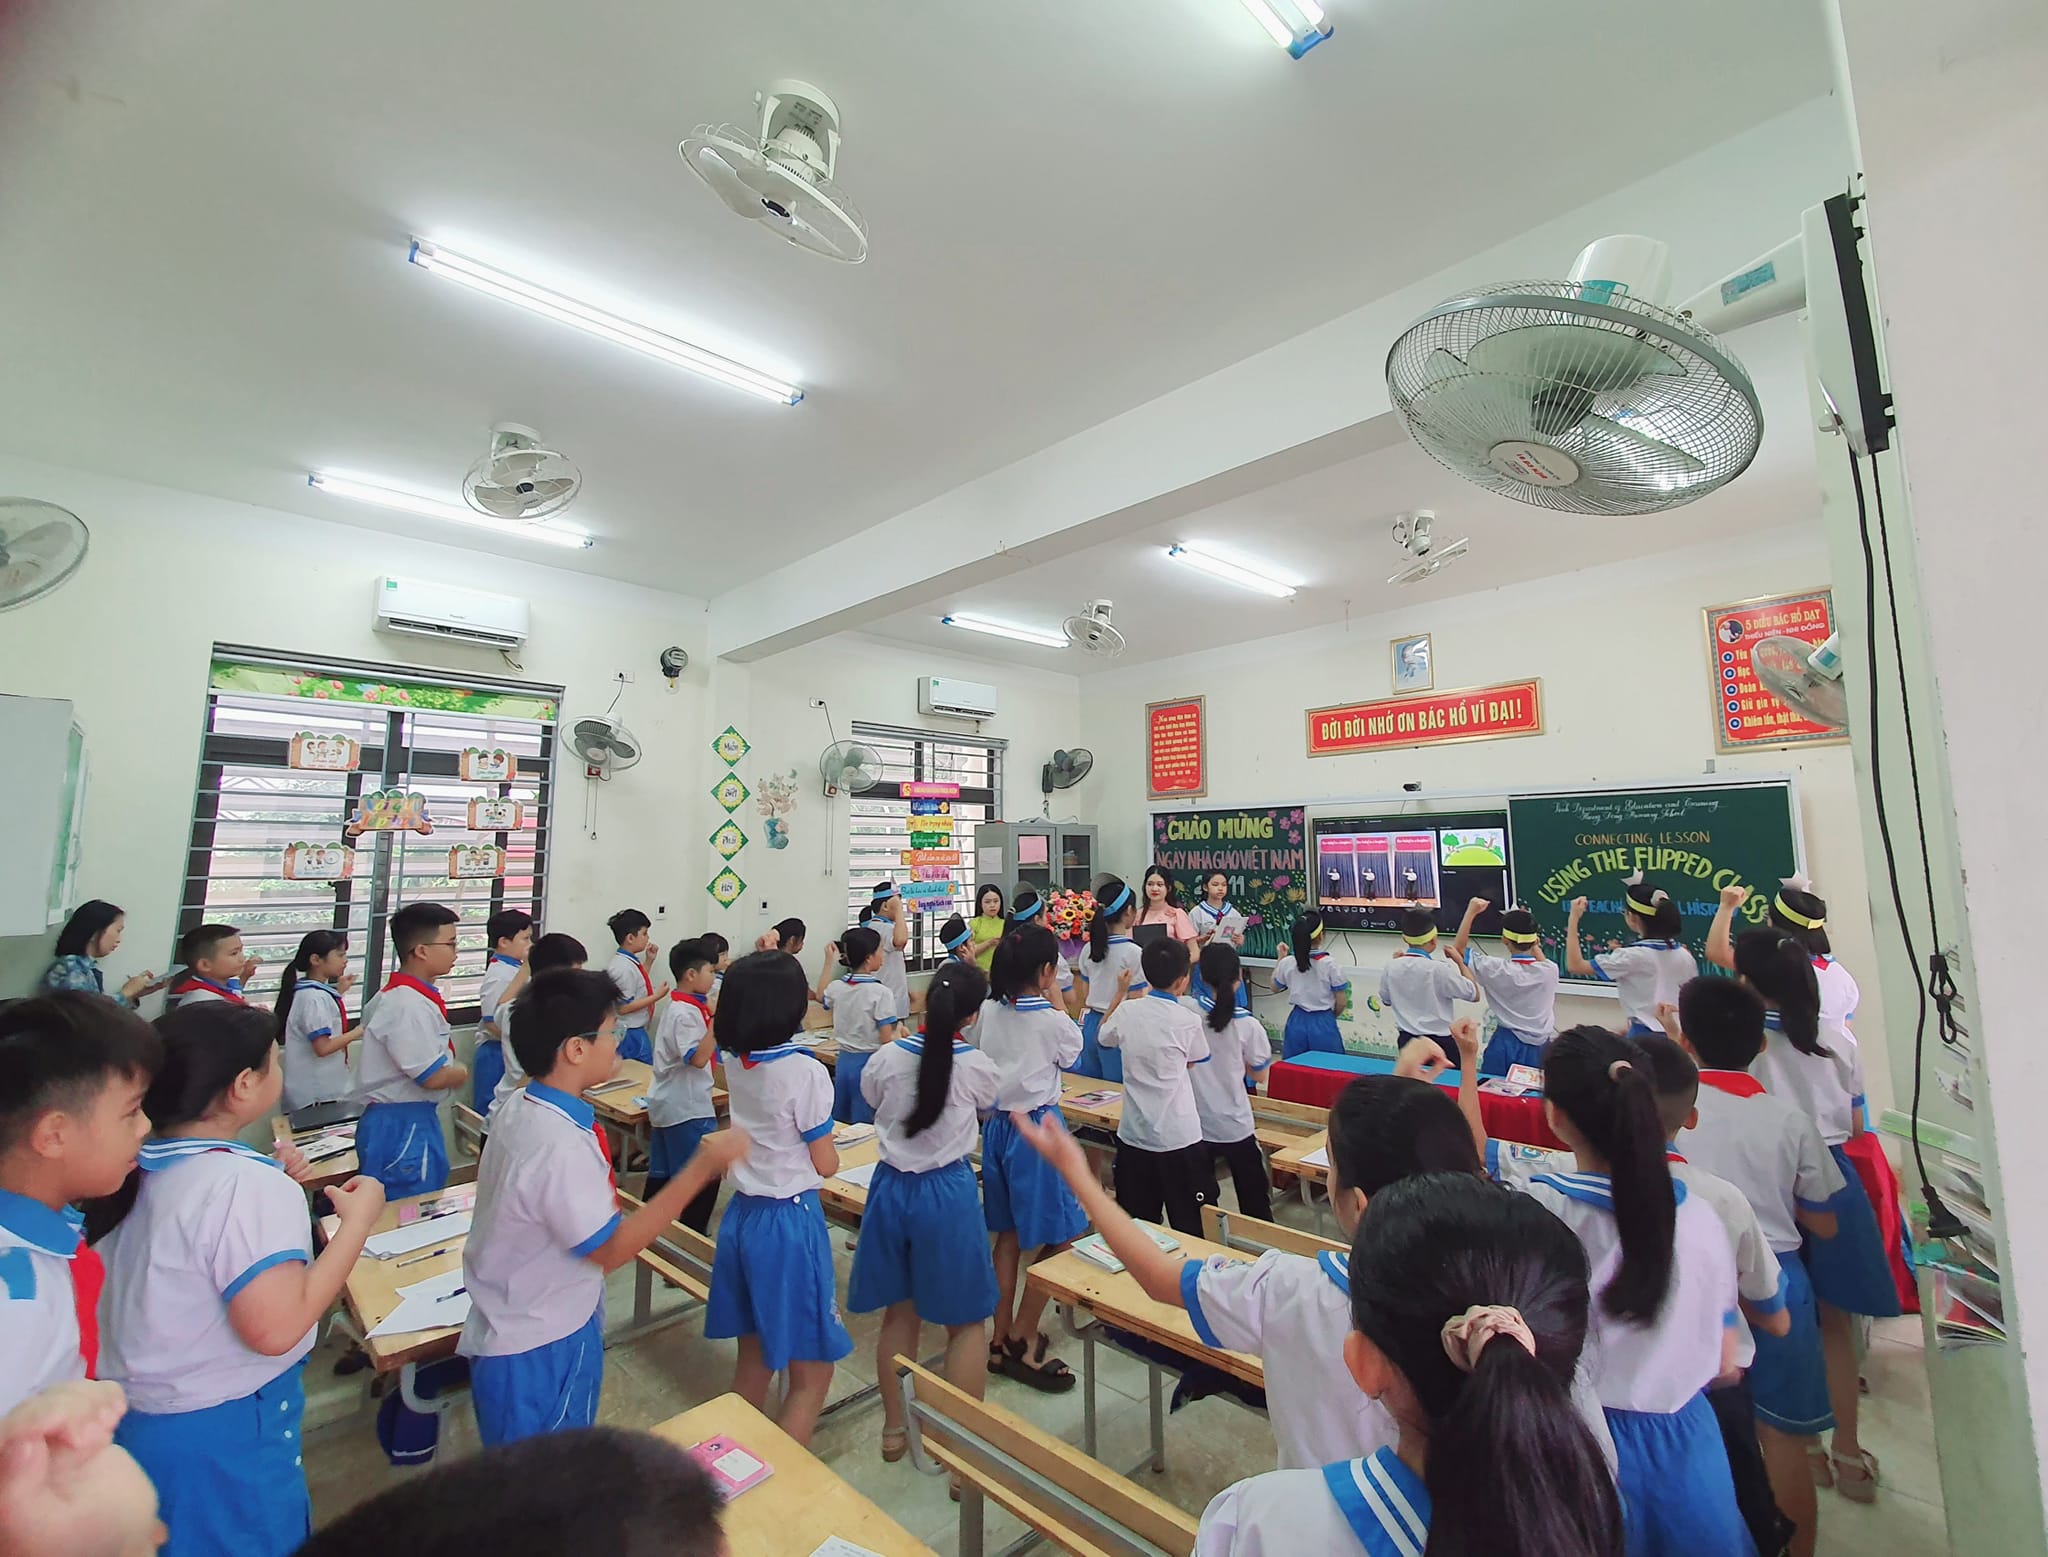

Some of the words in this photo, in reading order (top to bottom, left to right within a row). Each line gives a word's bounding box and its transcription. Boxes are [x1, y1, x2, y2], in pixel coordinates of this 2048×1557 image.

[1322, 717, 1342, 740] ĐỜI
[1344, 714, 1365, 738] ĐỜI
[1368, 709, 1394, 736] NHỚ
[1397, 711, 1415, 733] ƠN
[1418, 706, 1446, 730] BÁC
[1449, 699, 1468, 727] HỒ
[1471, 699, 1486, 724] VĨ
[1168, 814, 1211, 840] CHÀO
[1218, 812, 1273, 839] MỪNG
[1575, 832, 1653, 846] CONNECTING
[1660, 830, 1711, 845] LESSON
[1240, 845, 1268, 874] VIỆT
[1270, 848, 1304, 870] NAM
[1538, 858, 1592, 904] USING
[1587, 847, 1631, 873] THE
[1634, 845, 1713, 879] FLIPPED
